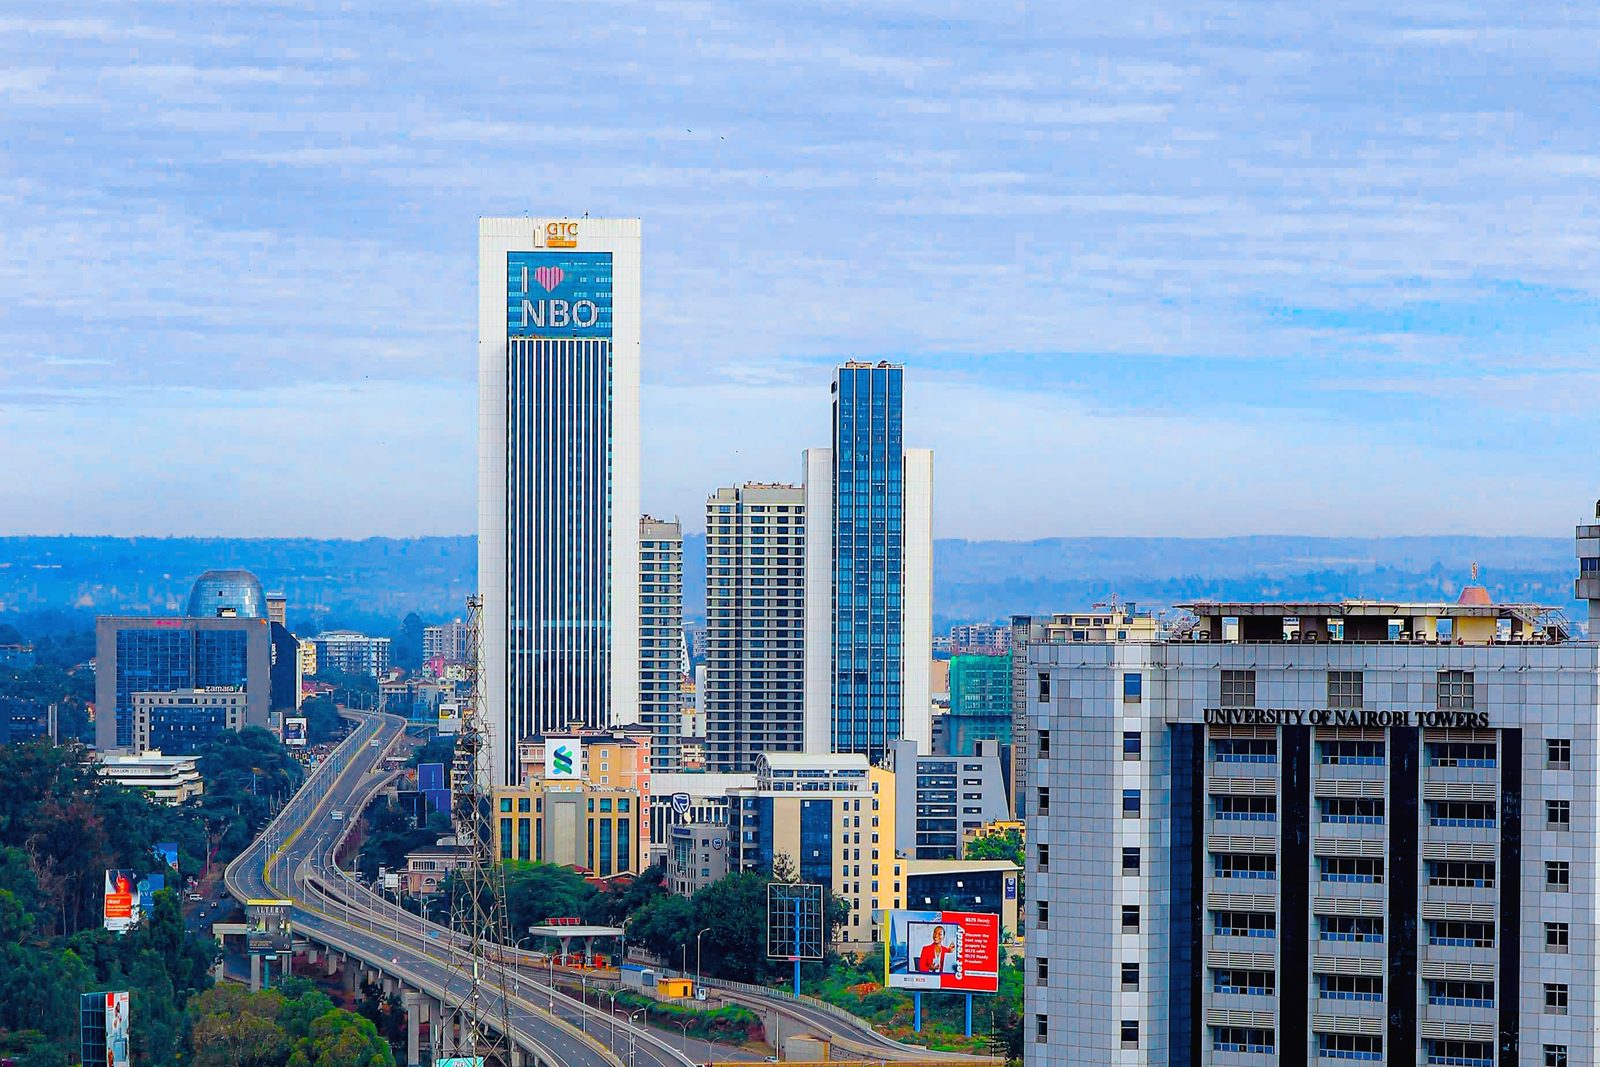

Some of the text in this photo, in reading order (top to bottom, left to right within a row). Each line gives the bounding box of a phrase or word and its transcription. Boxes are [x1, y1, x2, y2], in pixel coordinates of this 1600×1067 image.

[547, 222, 578, 236] GTC
[521, 266, 528, 293] I
[521, 299, 598, 328] NBO
[1203, 708, 1489, 728] UNIVERSITY OF NAIROBI TOWERS
[955, 925, 965, 980] Get ready
